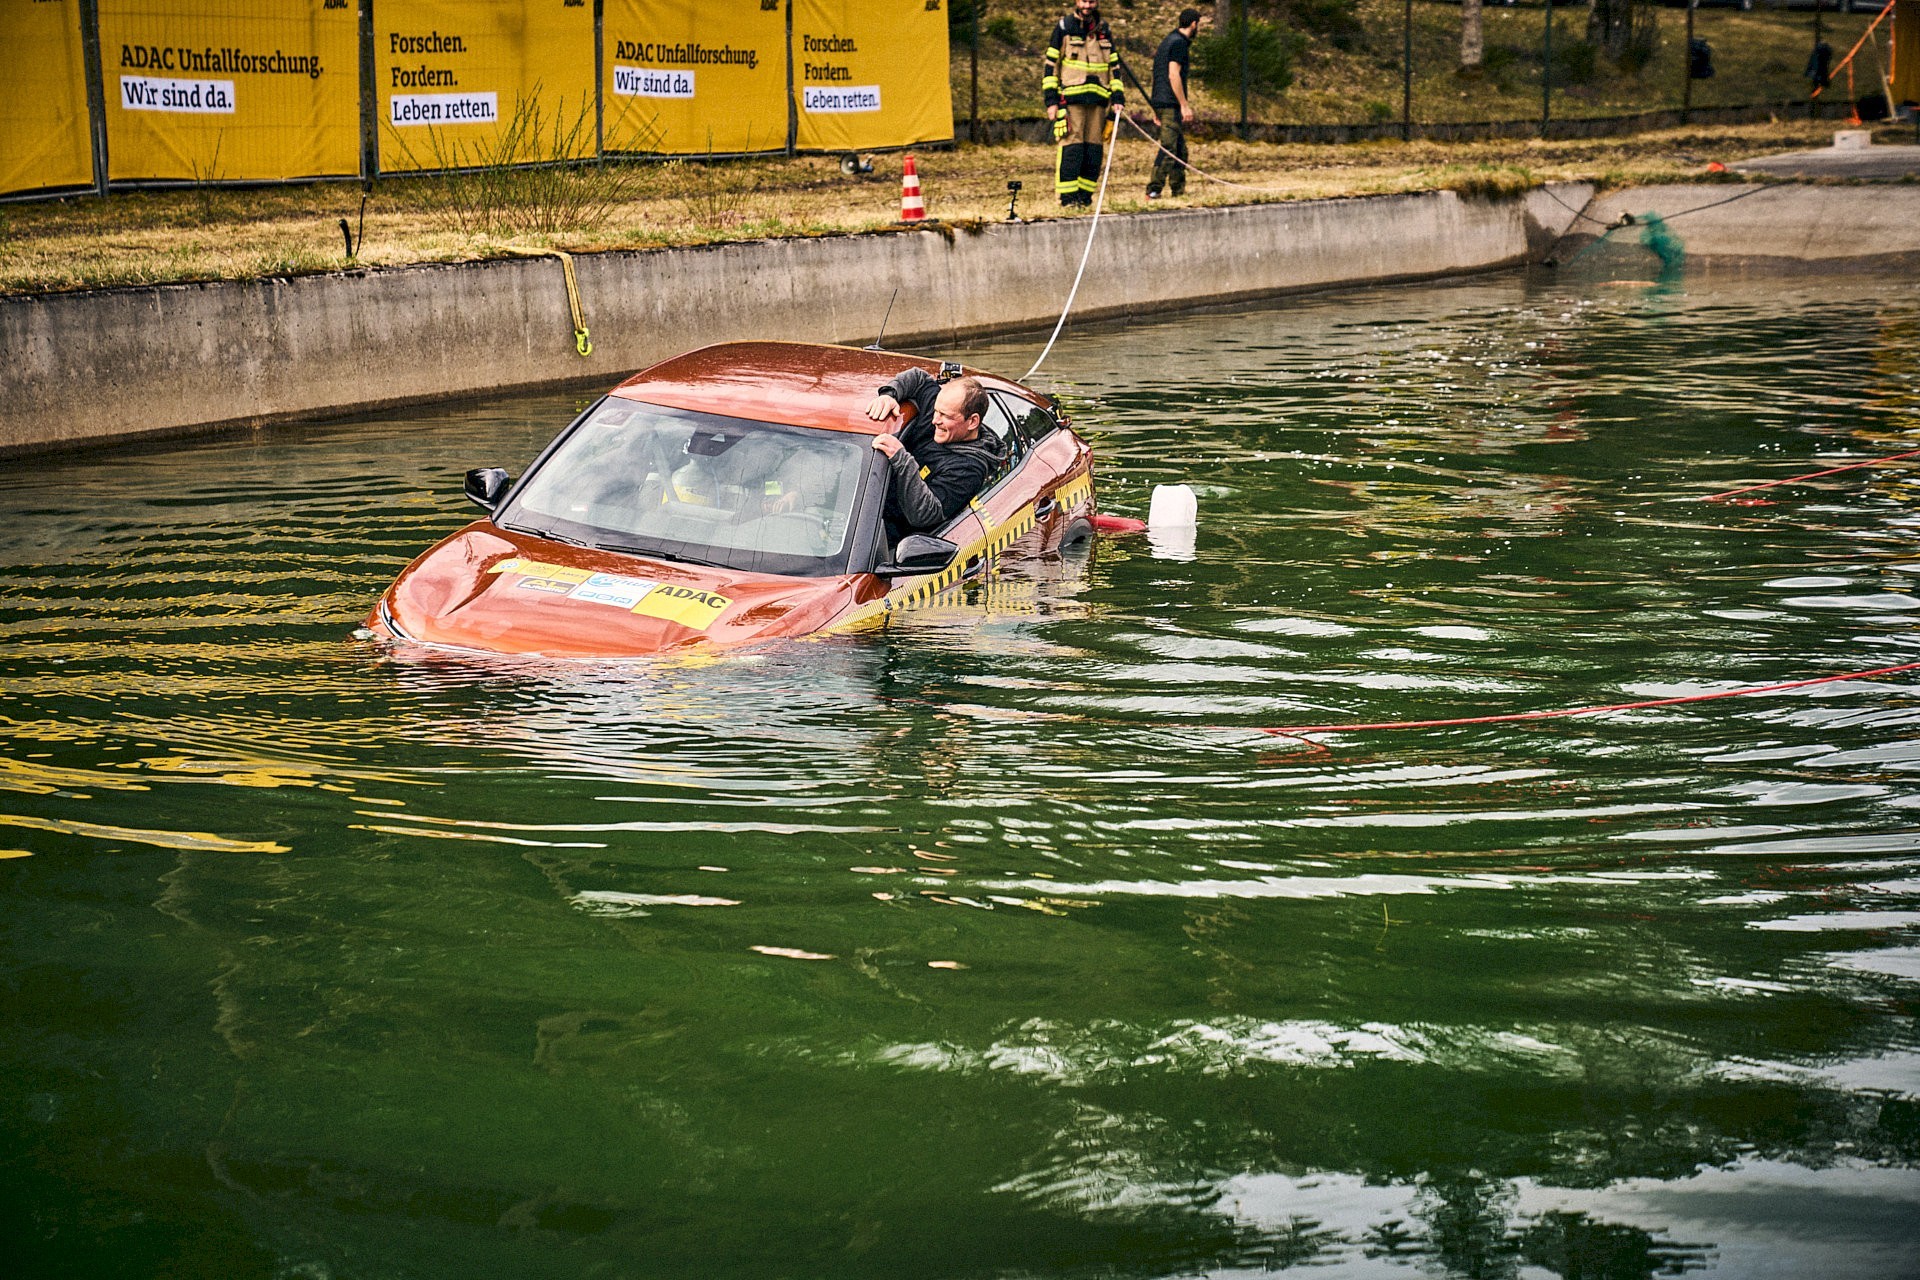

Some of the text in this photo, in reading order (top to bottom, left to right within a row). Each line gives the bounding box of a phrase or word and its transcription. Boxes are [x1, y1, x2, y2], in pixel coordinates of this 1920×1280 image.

[390, 31, 467, 53] Forschen.
[803, 33, 858, 52] Forschen.
[121, 45, 324, 79] ADAC Unfallforschung.
[615, 40, 759, 70] ADAC Unfallforschung.
[391, 65, 458, 87] Fordern.
[615, 70, 692, 94] Wir sind da.
[804, 62, 853, 80] Fordern.
[123, 80, 232, 109] Wir sind da.
[805, 90, 879, 109] Leben retten.
[393, 99, 495, 121] Leben retten.
[655, 586, 726, 609] ADAC
